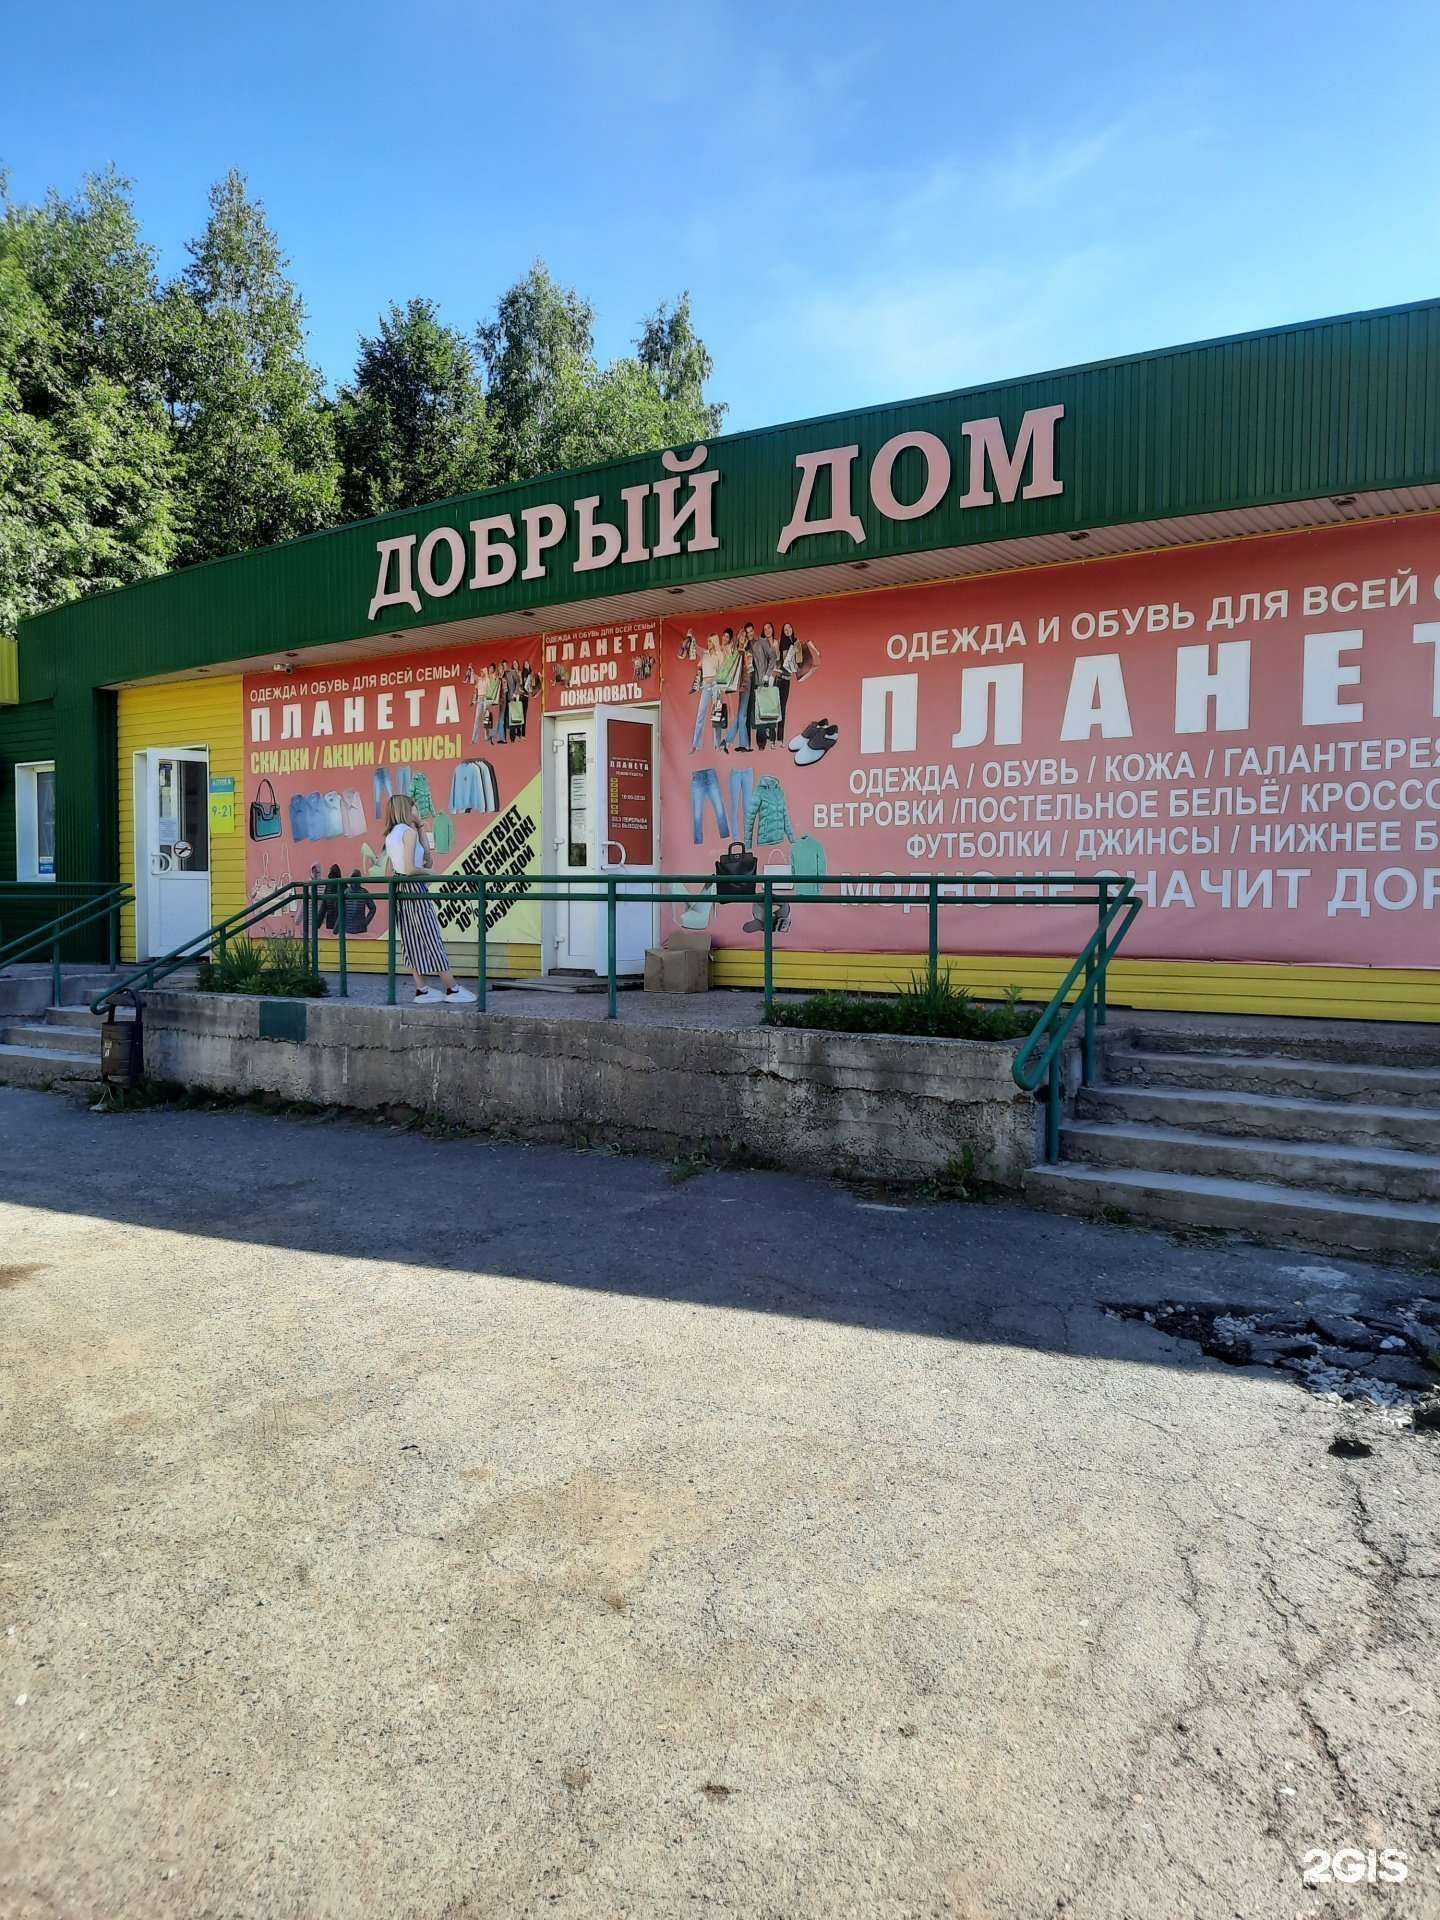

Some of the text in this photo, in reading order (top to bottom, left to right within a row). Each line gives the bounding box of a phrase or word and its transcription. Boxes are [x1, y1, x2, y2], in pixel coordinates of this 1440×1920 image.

[368, 404, 1065, 621] ДОБРЫЙ ДОМ
[887, 621, 1027, 662] ОДЕЖДА
[1038, 617, 1060, 644] И
[1071, 600, 1196, 640] ОБУВЬ
[1207, 589, 1289, 630] ДЛЯ
[1303, 568, 1418, 616] ВСЕЙ
[546, 632, 656, 662] ПЛАНЕТА
[250, 664, 460, 703] ОДЕЖДА И ОБУВЬ ДЛЯ ВСЕЙ СЕМЬИ
[560, 682, 643, 706] ПОЖАЛОВАТЬ
[569, 660, 618, 688] ДОБРО
[251, 685, 460, 743] ПЛАНЕТА
[250, 747, 309, 775] СКИДКИ
[322, 741, 375, 770] АКЦИИ
[389, 733, 462, 763] БОНУСЫ
[850, 764, 959, 798] ОДЕЖДА
[982, 758, 1079, 788] ОБУВЬ
[1105, 751, 1196, 783] КОЖА
[813, 799, 945, 828] ВЕТРОВКИ
[461, 804, 522, 876] ДЕЙСТВУЕТ
[484, 815, 537, 876] СКИДОК!
[906, 830, 1050, 859] ФУТБОЛКИ
[1075, 825, 1220, 862] ДЖИНСЫ
[1250, 821, 1401, 854] НИЖНЕЕ
[840, 871, 999, 913] МОДНО
[1015, 870, 1076, 908] НЕ
